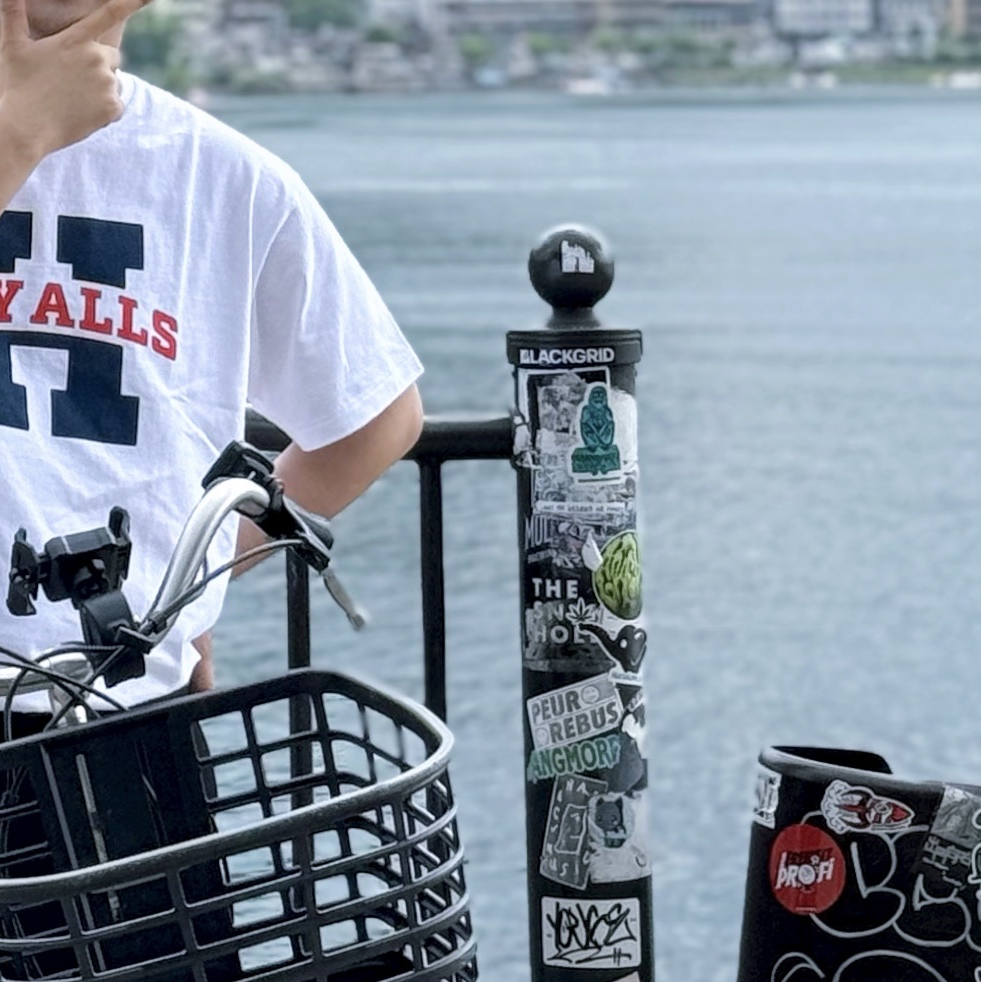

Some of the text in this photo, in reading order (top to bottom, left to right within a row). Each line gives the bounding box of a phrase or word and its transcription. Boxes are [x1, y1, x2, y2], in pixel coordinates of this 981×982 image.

[519, 348, 615, 364] BLACKGRID
[532, 577, 579, 598] THE
[532, 690, 582, 724] PEUR
[549, 701, 619, 744] REBUS
